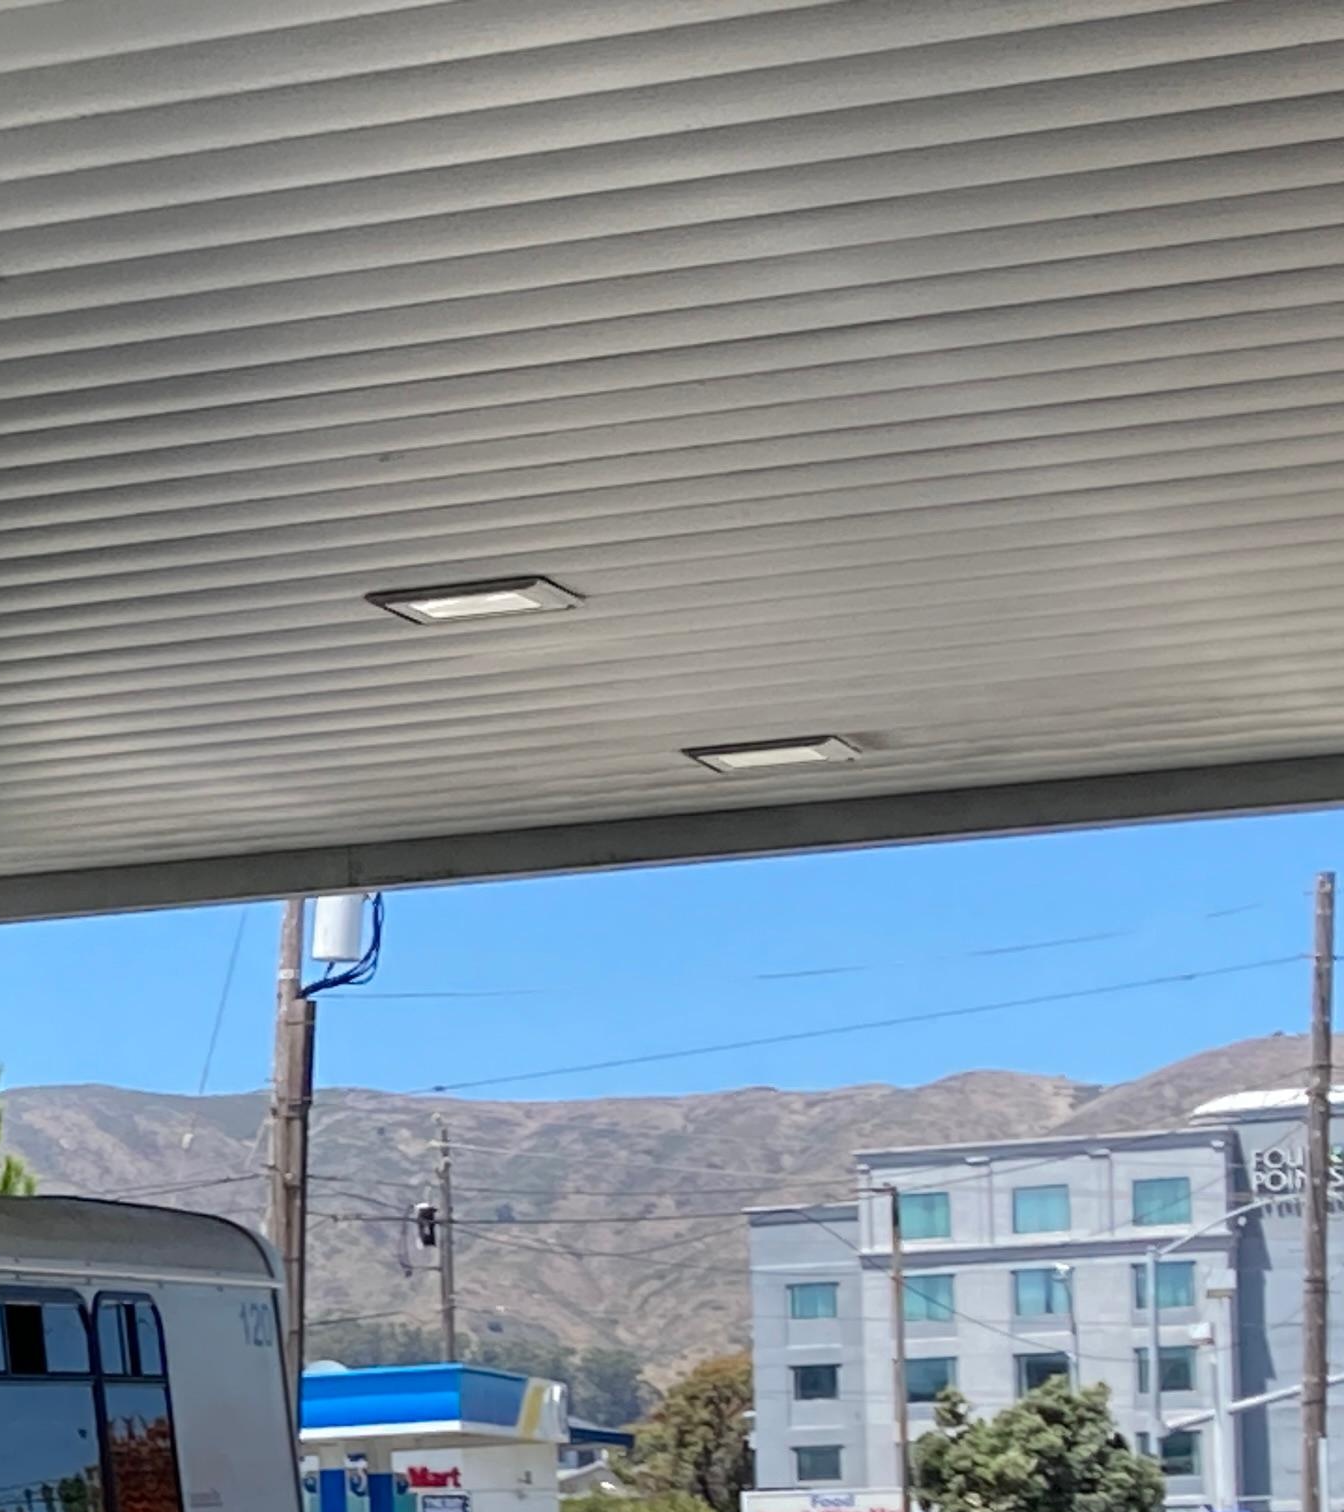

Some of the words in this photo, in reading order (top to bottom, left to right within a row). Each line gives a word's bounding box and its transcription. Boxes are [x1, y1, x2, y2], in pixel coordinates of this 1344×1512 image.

[1252, 1146, 1305, 1172] FOU
[1252, 1168, 1344, 1193] POINS
[240, 1302, 274, 1347] 120
[407, 1465, 462, 1488] Mart
[811, 1493, 855, 1507] Food
